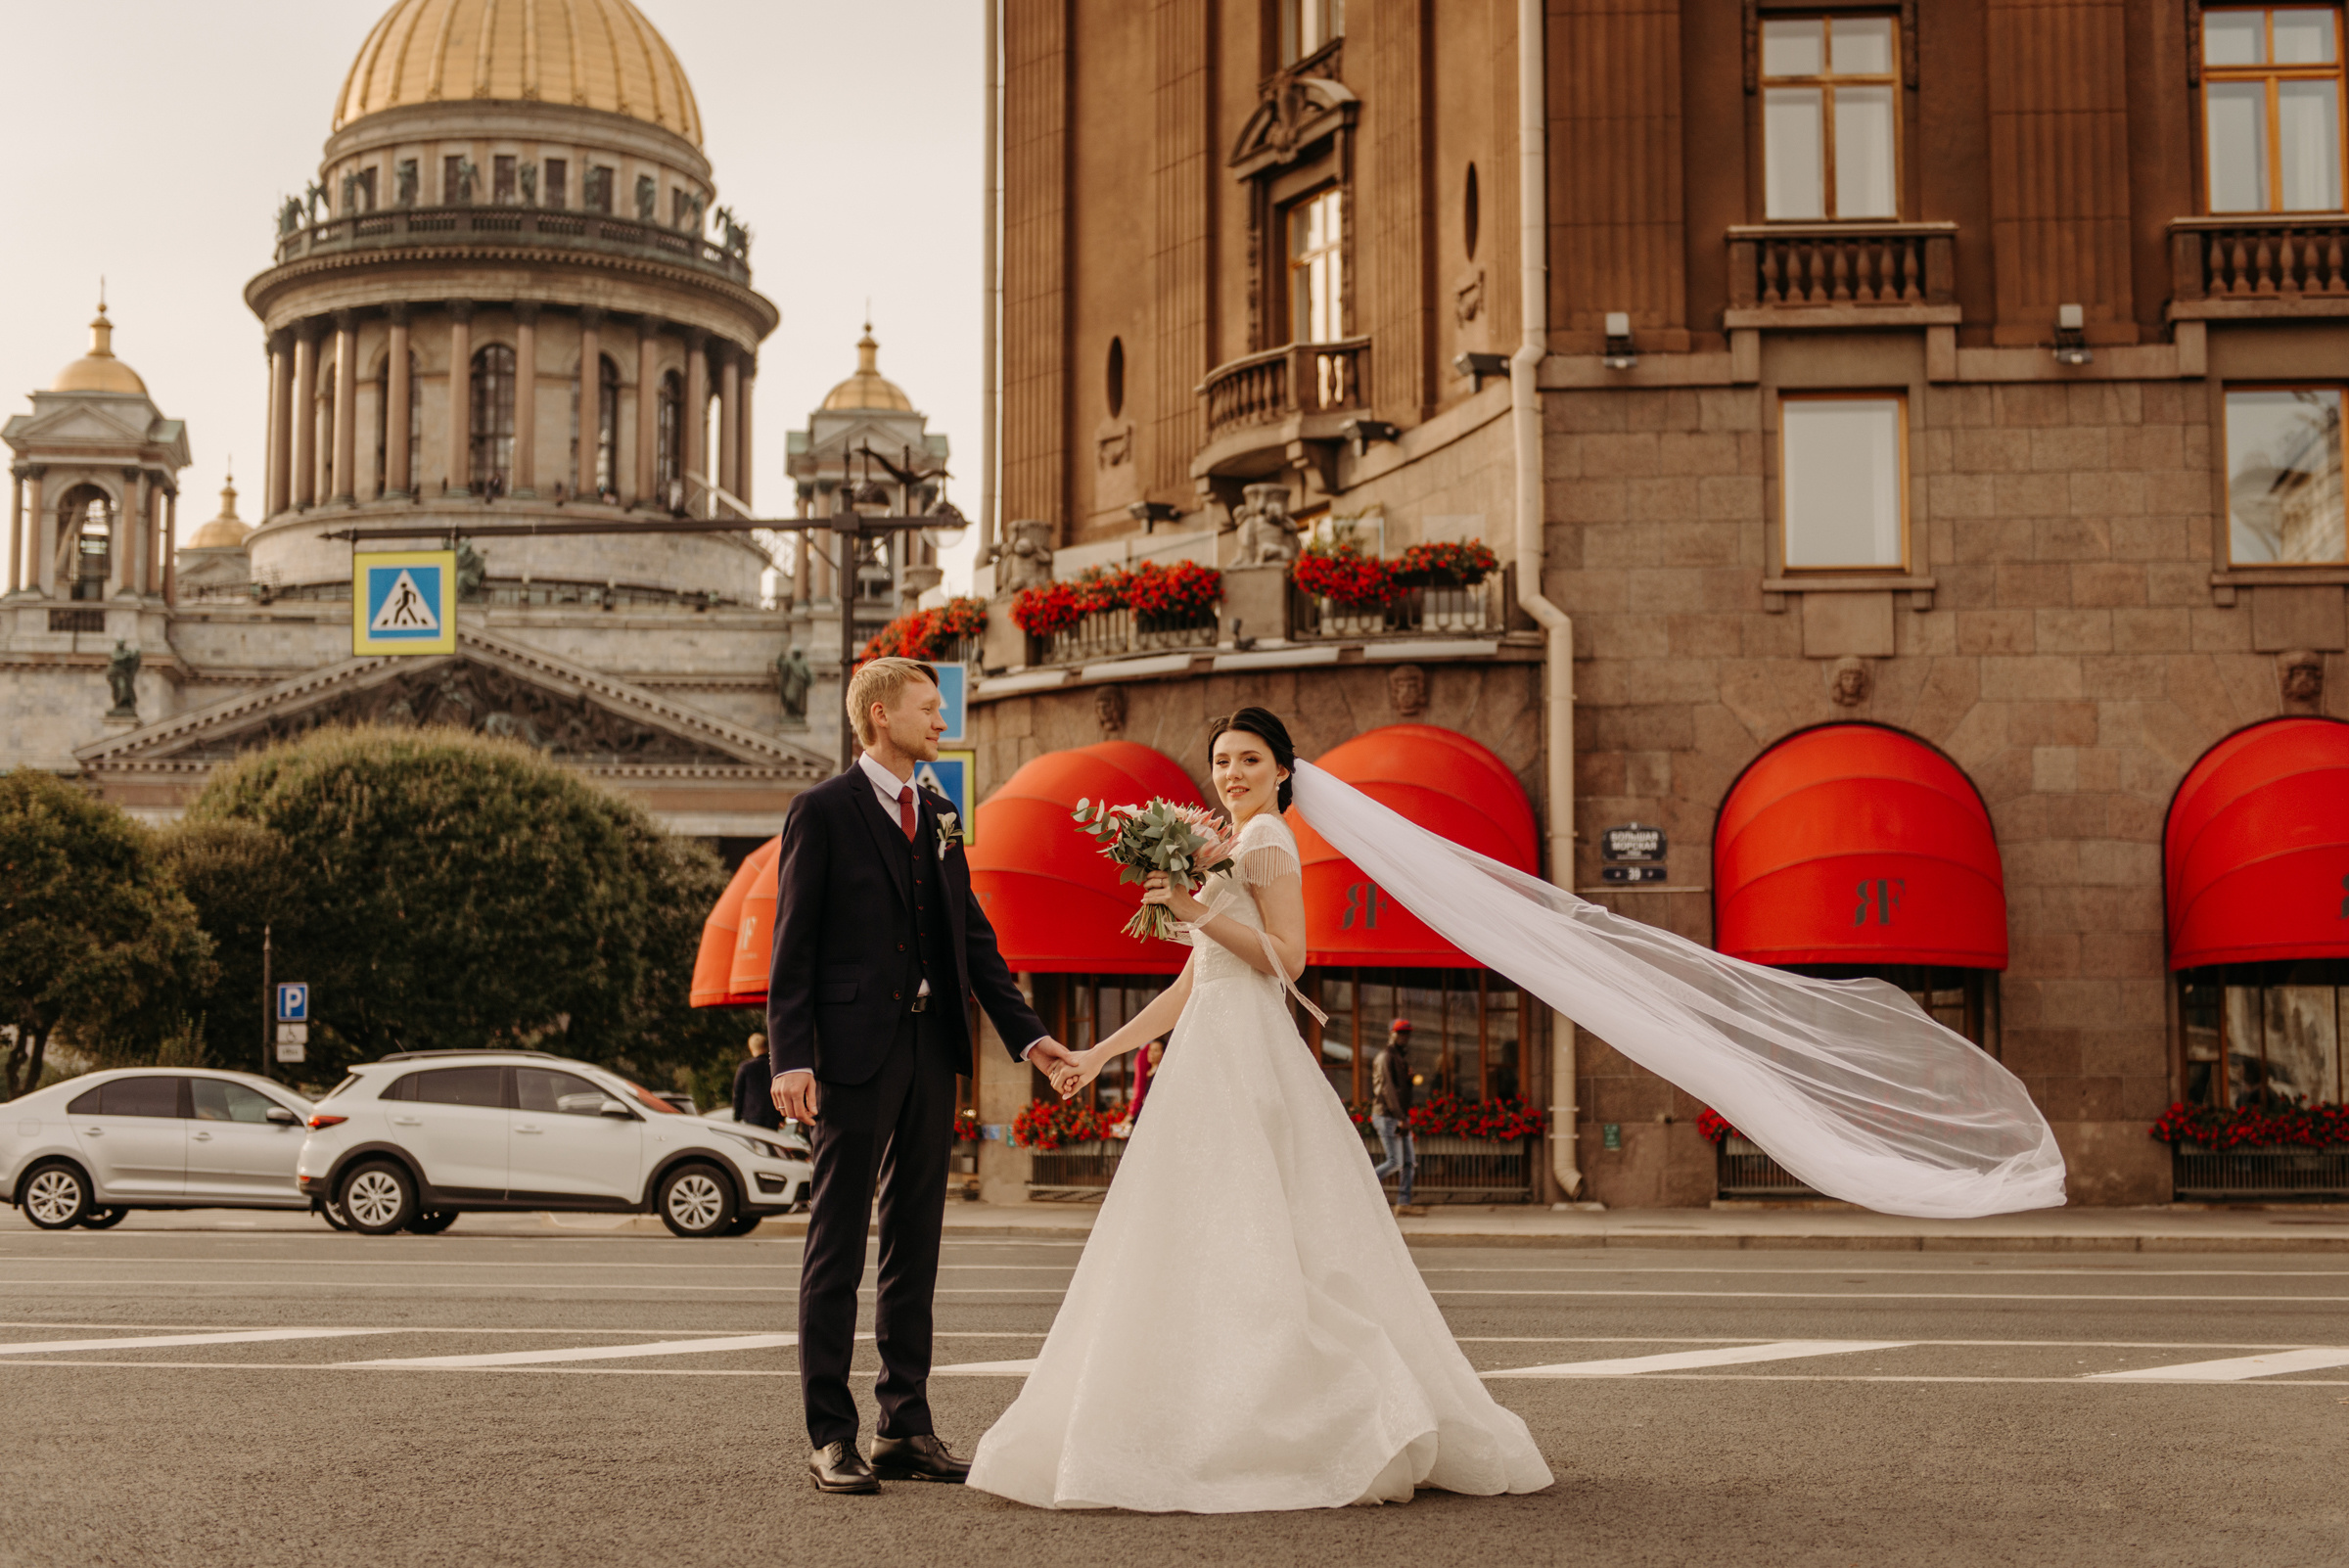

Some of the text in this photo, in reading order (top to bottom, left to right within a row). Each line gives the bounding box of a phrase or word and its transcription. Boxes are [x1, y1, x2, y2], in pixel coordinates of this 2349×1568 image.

[1610, 831, 1658, 842] БОЛЬШАЯ
[1612, 842, 1657, 851] МОРСКАЯ
[285, 988, 303, 1017] P
